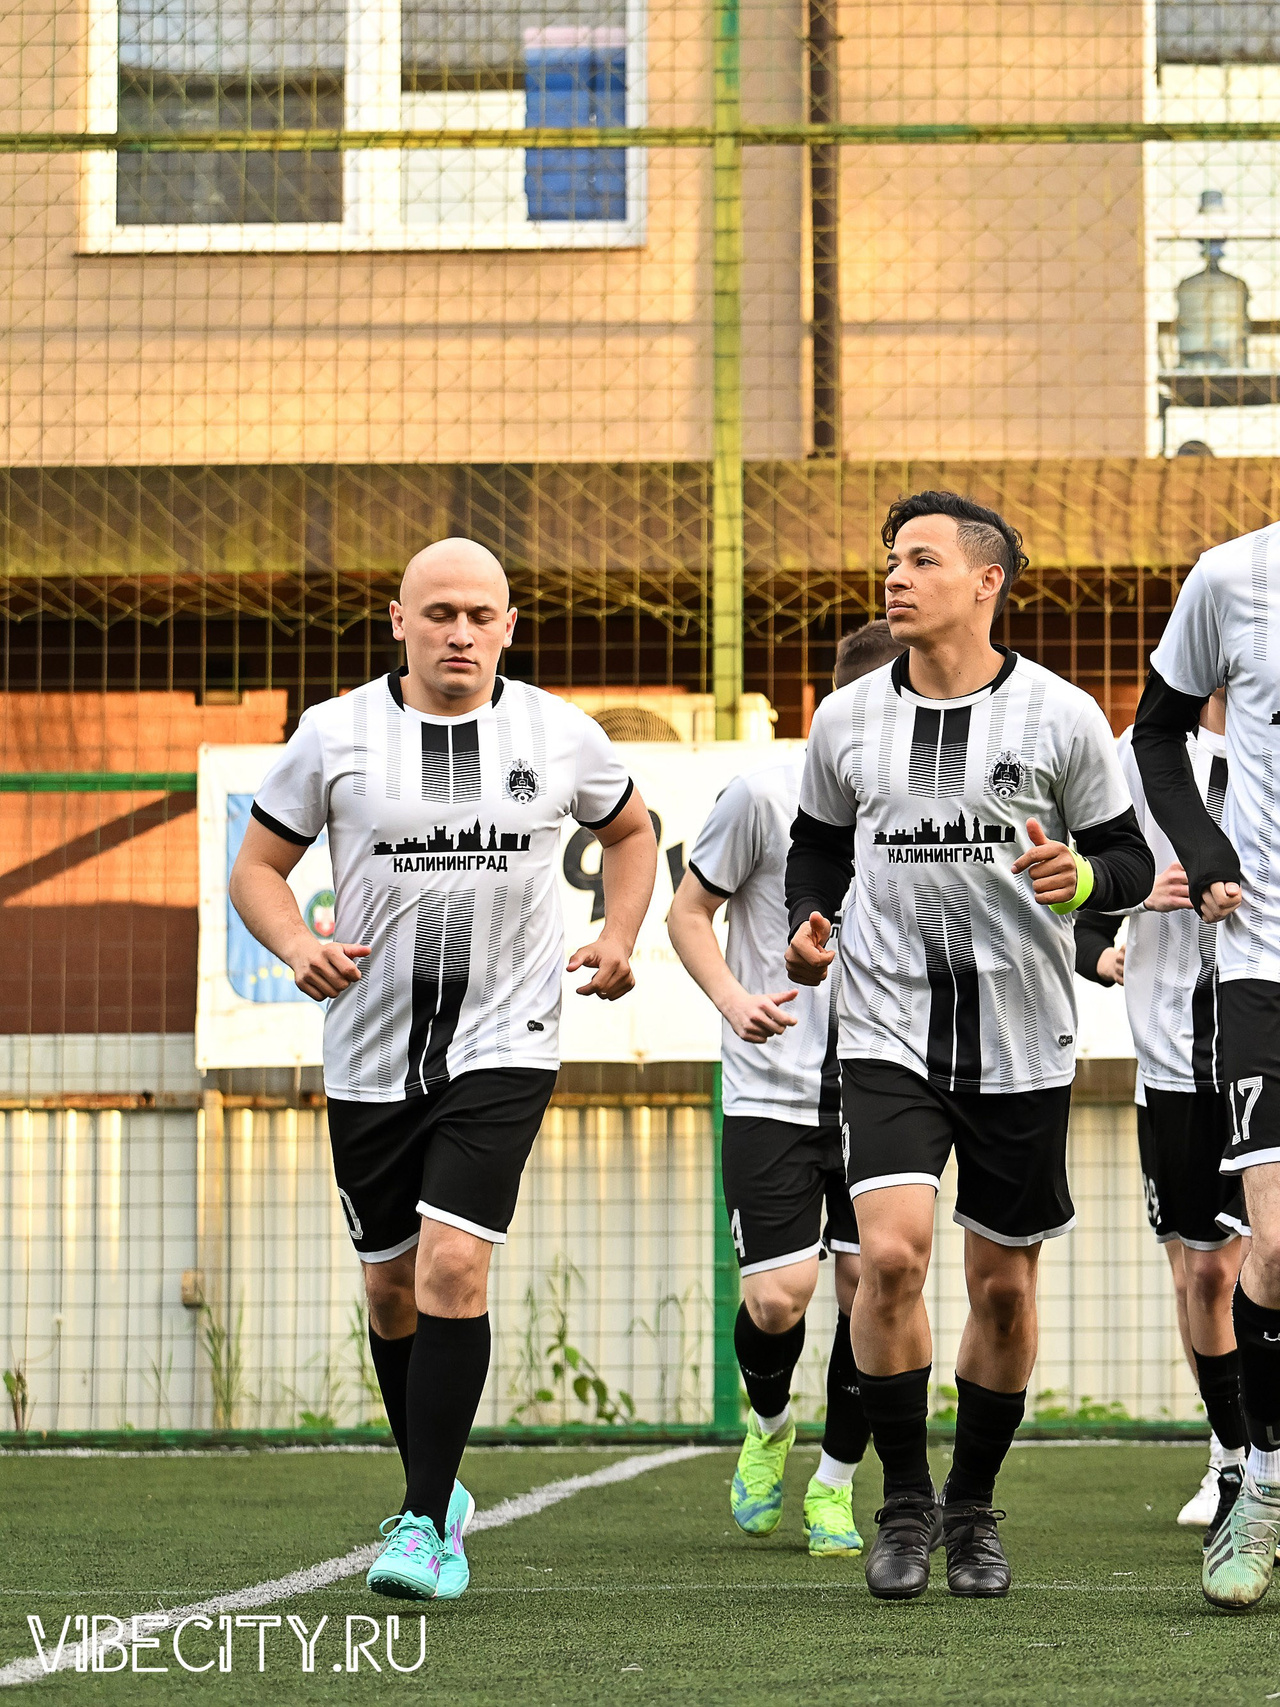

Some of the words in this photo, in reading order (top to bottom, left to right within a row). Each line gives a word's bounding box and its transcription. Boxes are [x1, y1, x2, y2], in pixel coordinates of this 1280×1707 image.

[393, 855, 508, 873] КАЛИНИНГРАД
[888, 846, 995, 864] КАЛИНИНГРАД
[1229, 1075, 1263, 1145] 17
